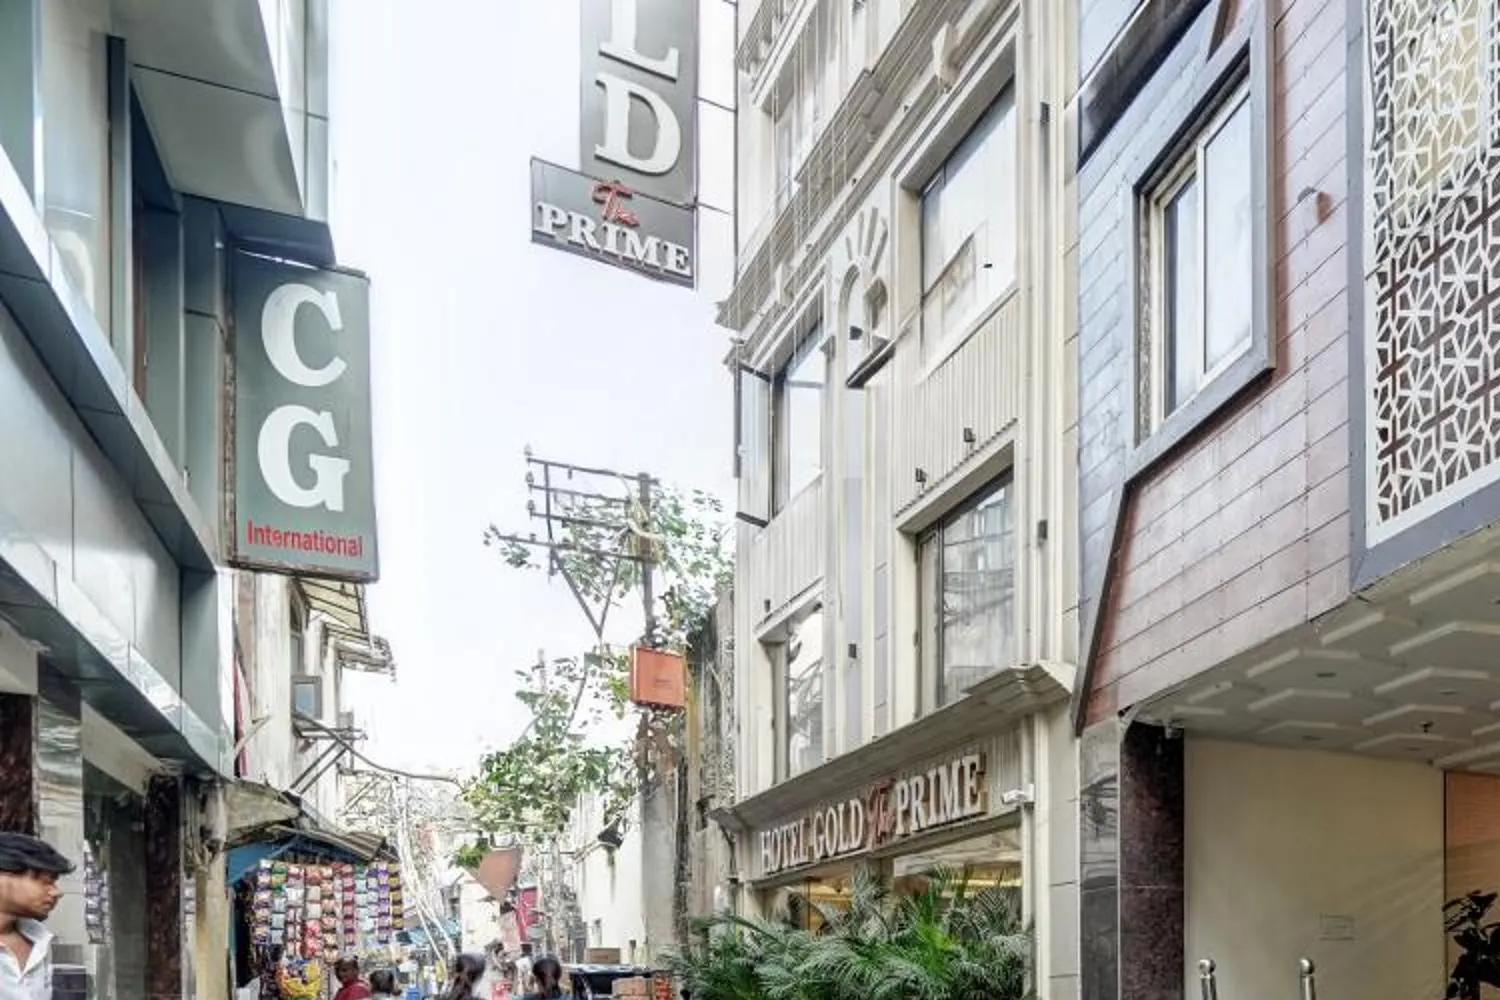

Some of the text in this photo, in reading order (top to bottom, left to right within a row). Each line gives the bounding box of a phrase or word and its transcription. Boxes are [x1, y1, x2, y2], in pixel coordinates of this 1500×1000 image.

[535, 201, 693, 277] PRIME
[257, 283, 351, 512] CG
[247, 520, 364, 557] International
[761, 818, 811, 874] HOTEL
[813, 798, 865, 858] GOLD
[896, 754, 984, 836] PRIME
